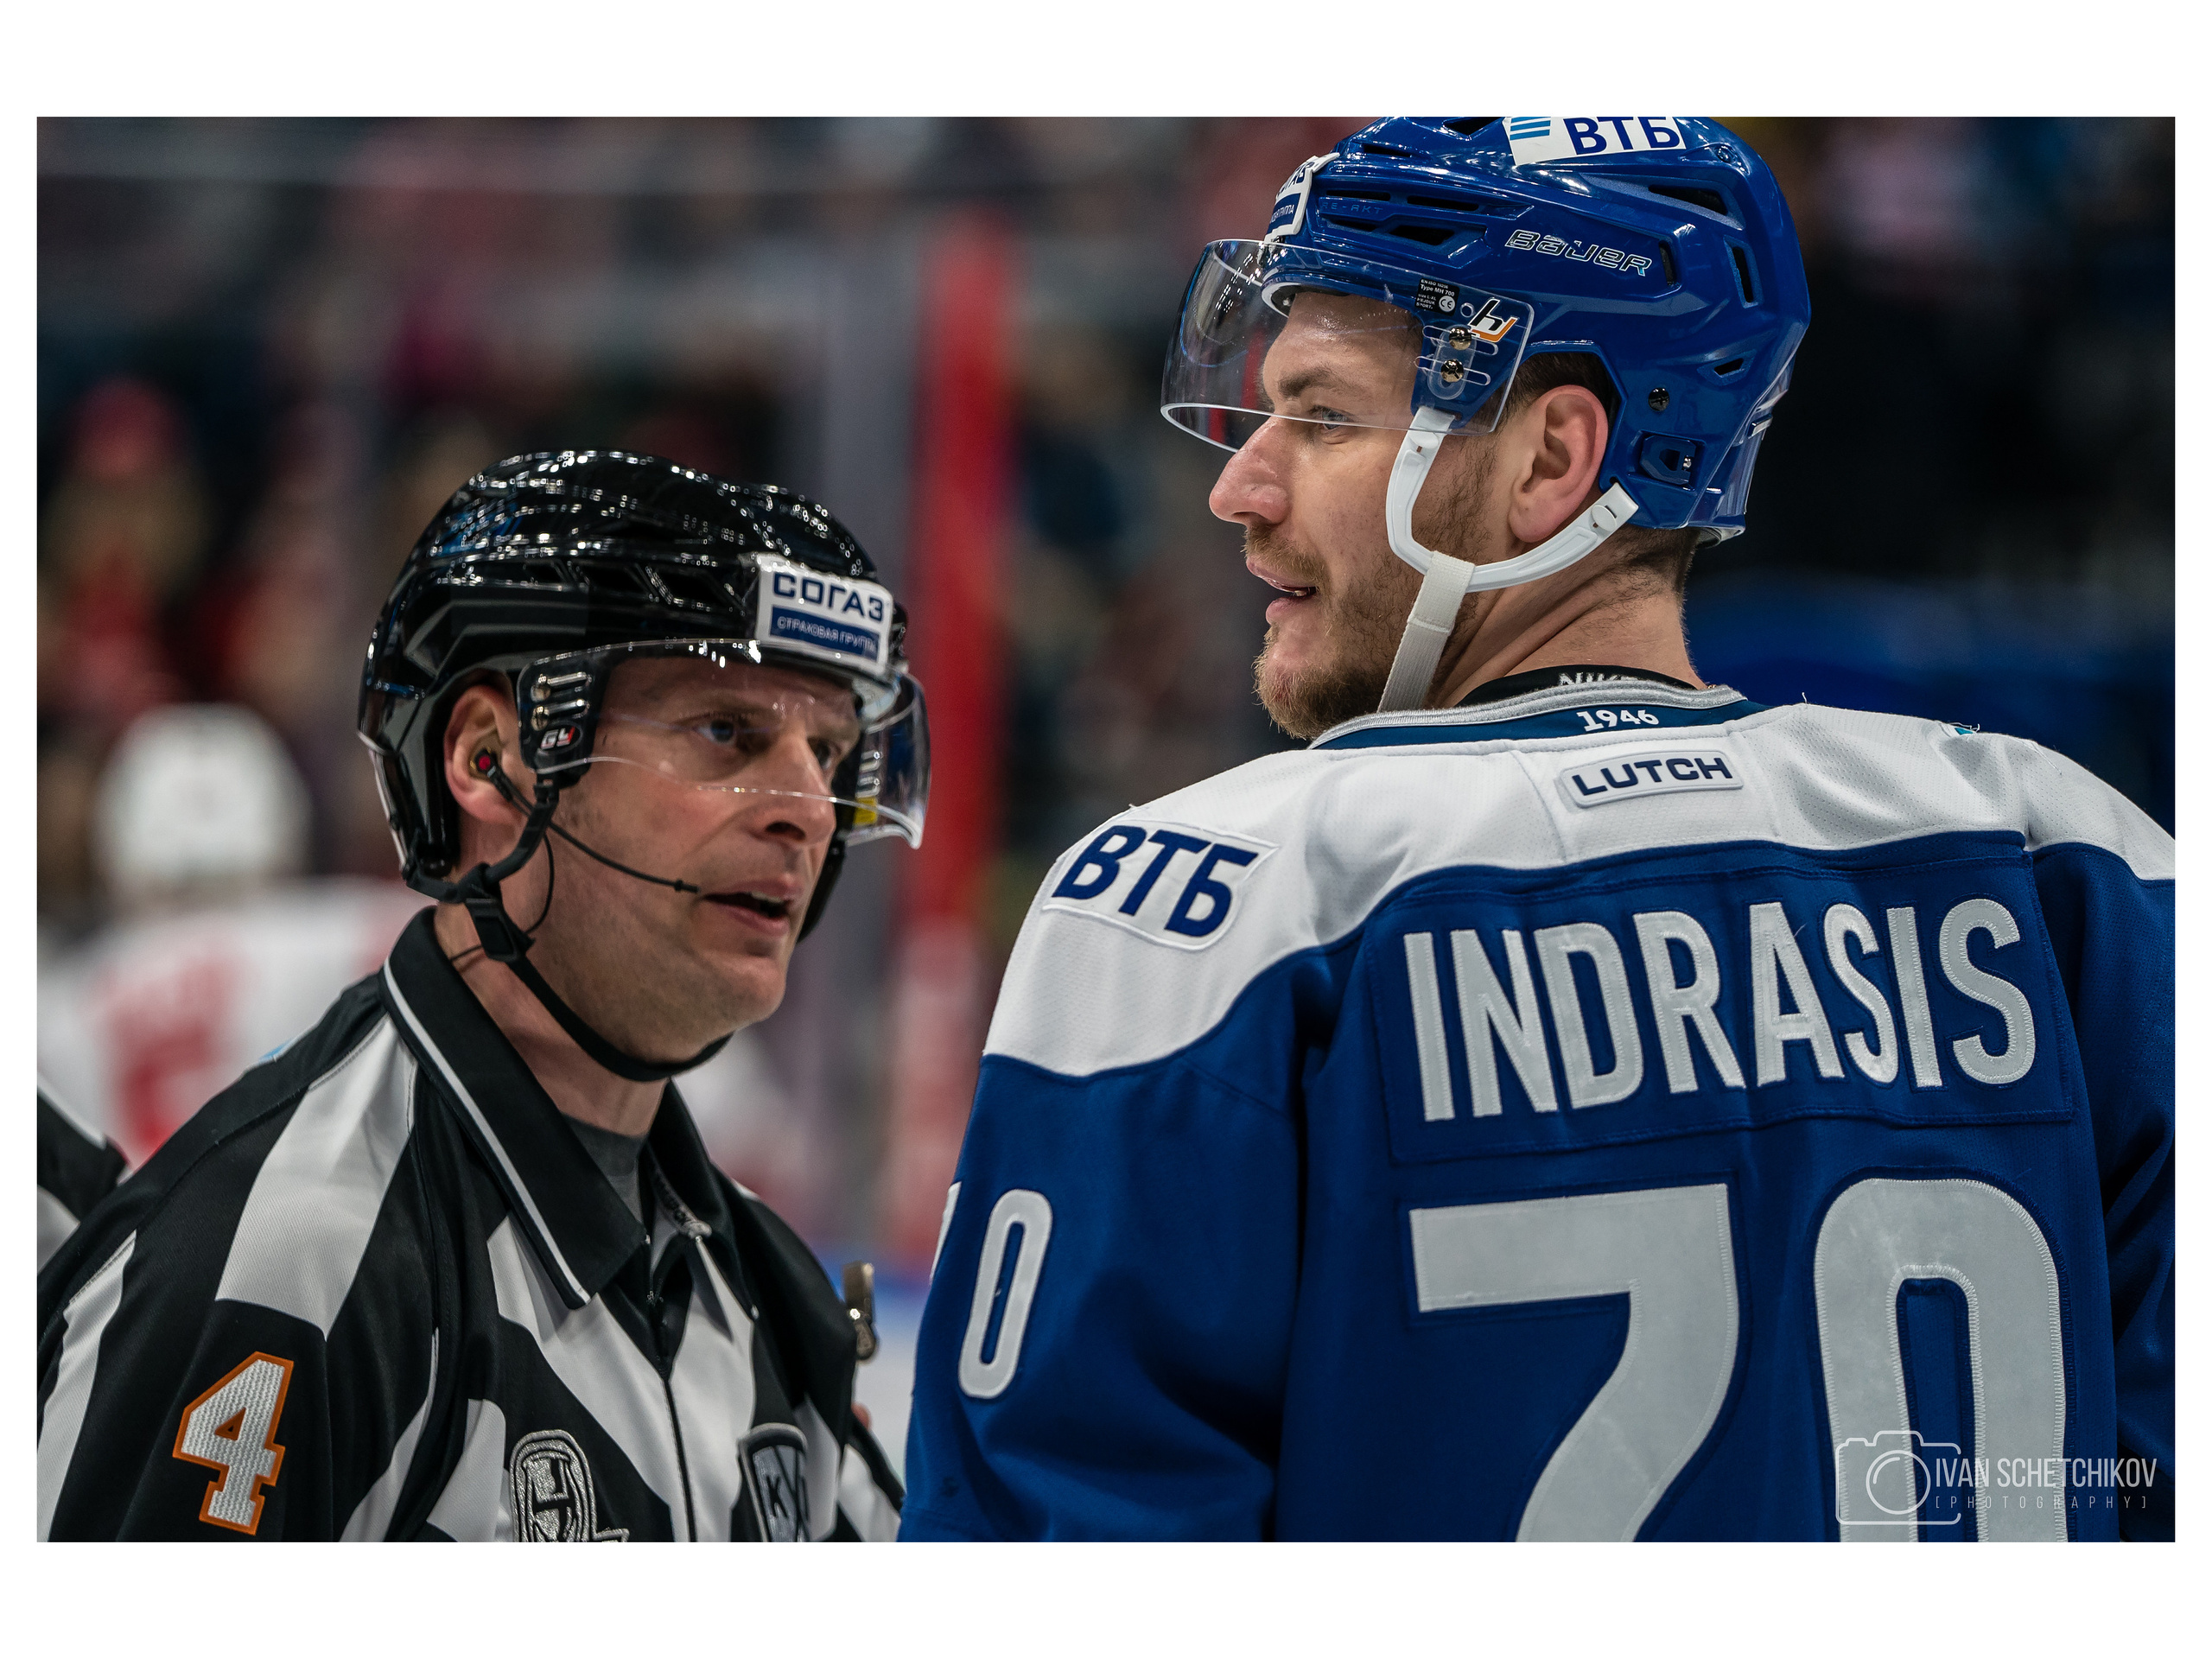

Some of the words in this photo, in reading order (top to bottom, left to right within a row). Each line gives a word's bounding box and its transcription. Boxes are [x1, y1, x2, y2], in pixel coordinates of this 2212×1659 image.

[1563, 117, 1680, 156] ВТБ
[1420, 283, 1434, 292] Type
[773, 572, 884, 622] СОГАЗ
[778, 616, 839, 642] СТРАХОВАЯ
[1576, 709, 1660, 732] 1946
[1572, 757, 1733, 796] LUTCH
[1052, 825, 1259, 938] ВТБ
[1403, 898, 2037, 1122] INDRASIS
[1409, 1177, 2069, 1543] 70
[172, 1351, 295, 1536] 4
